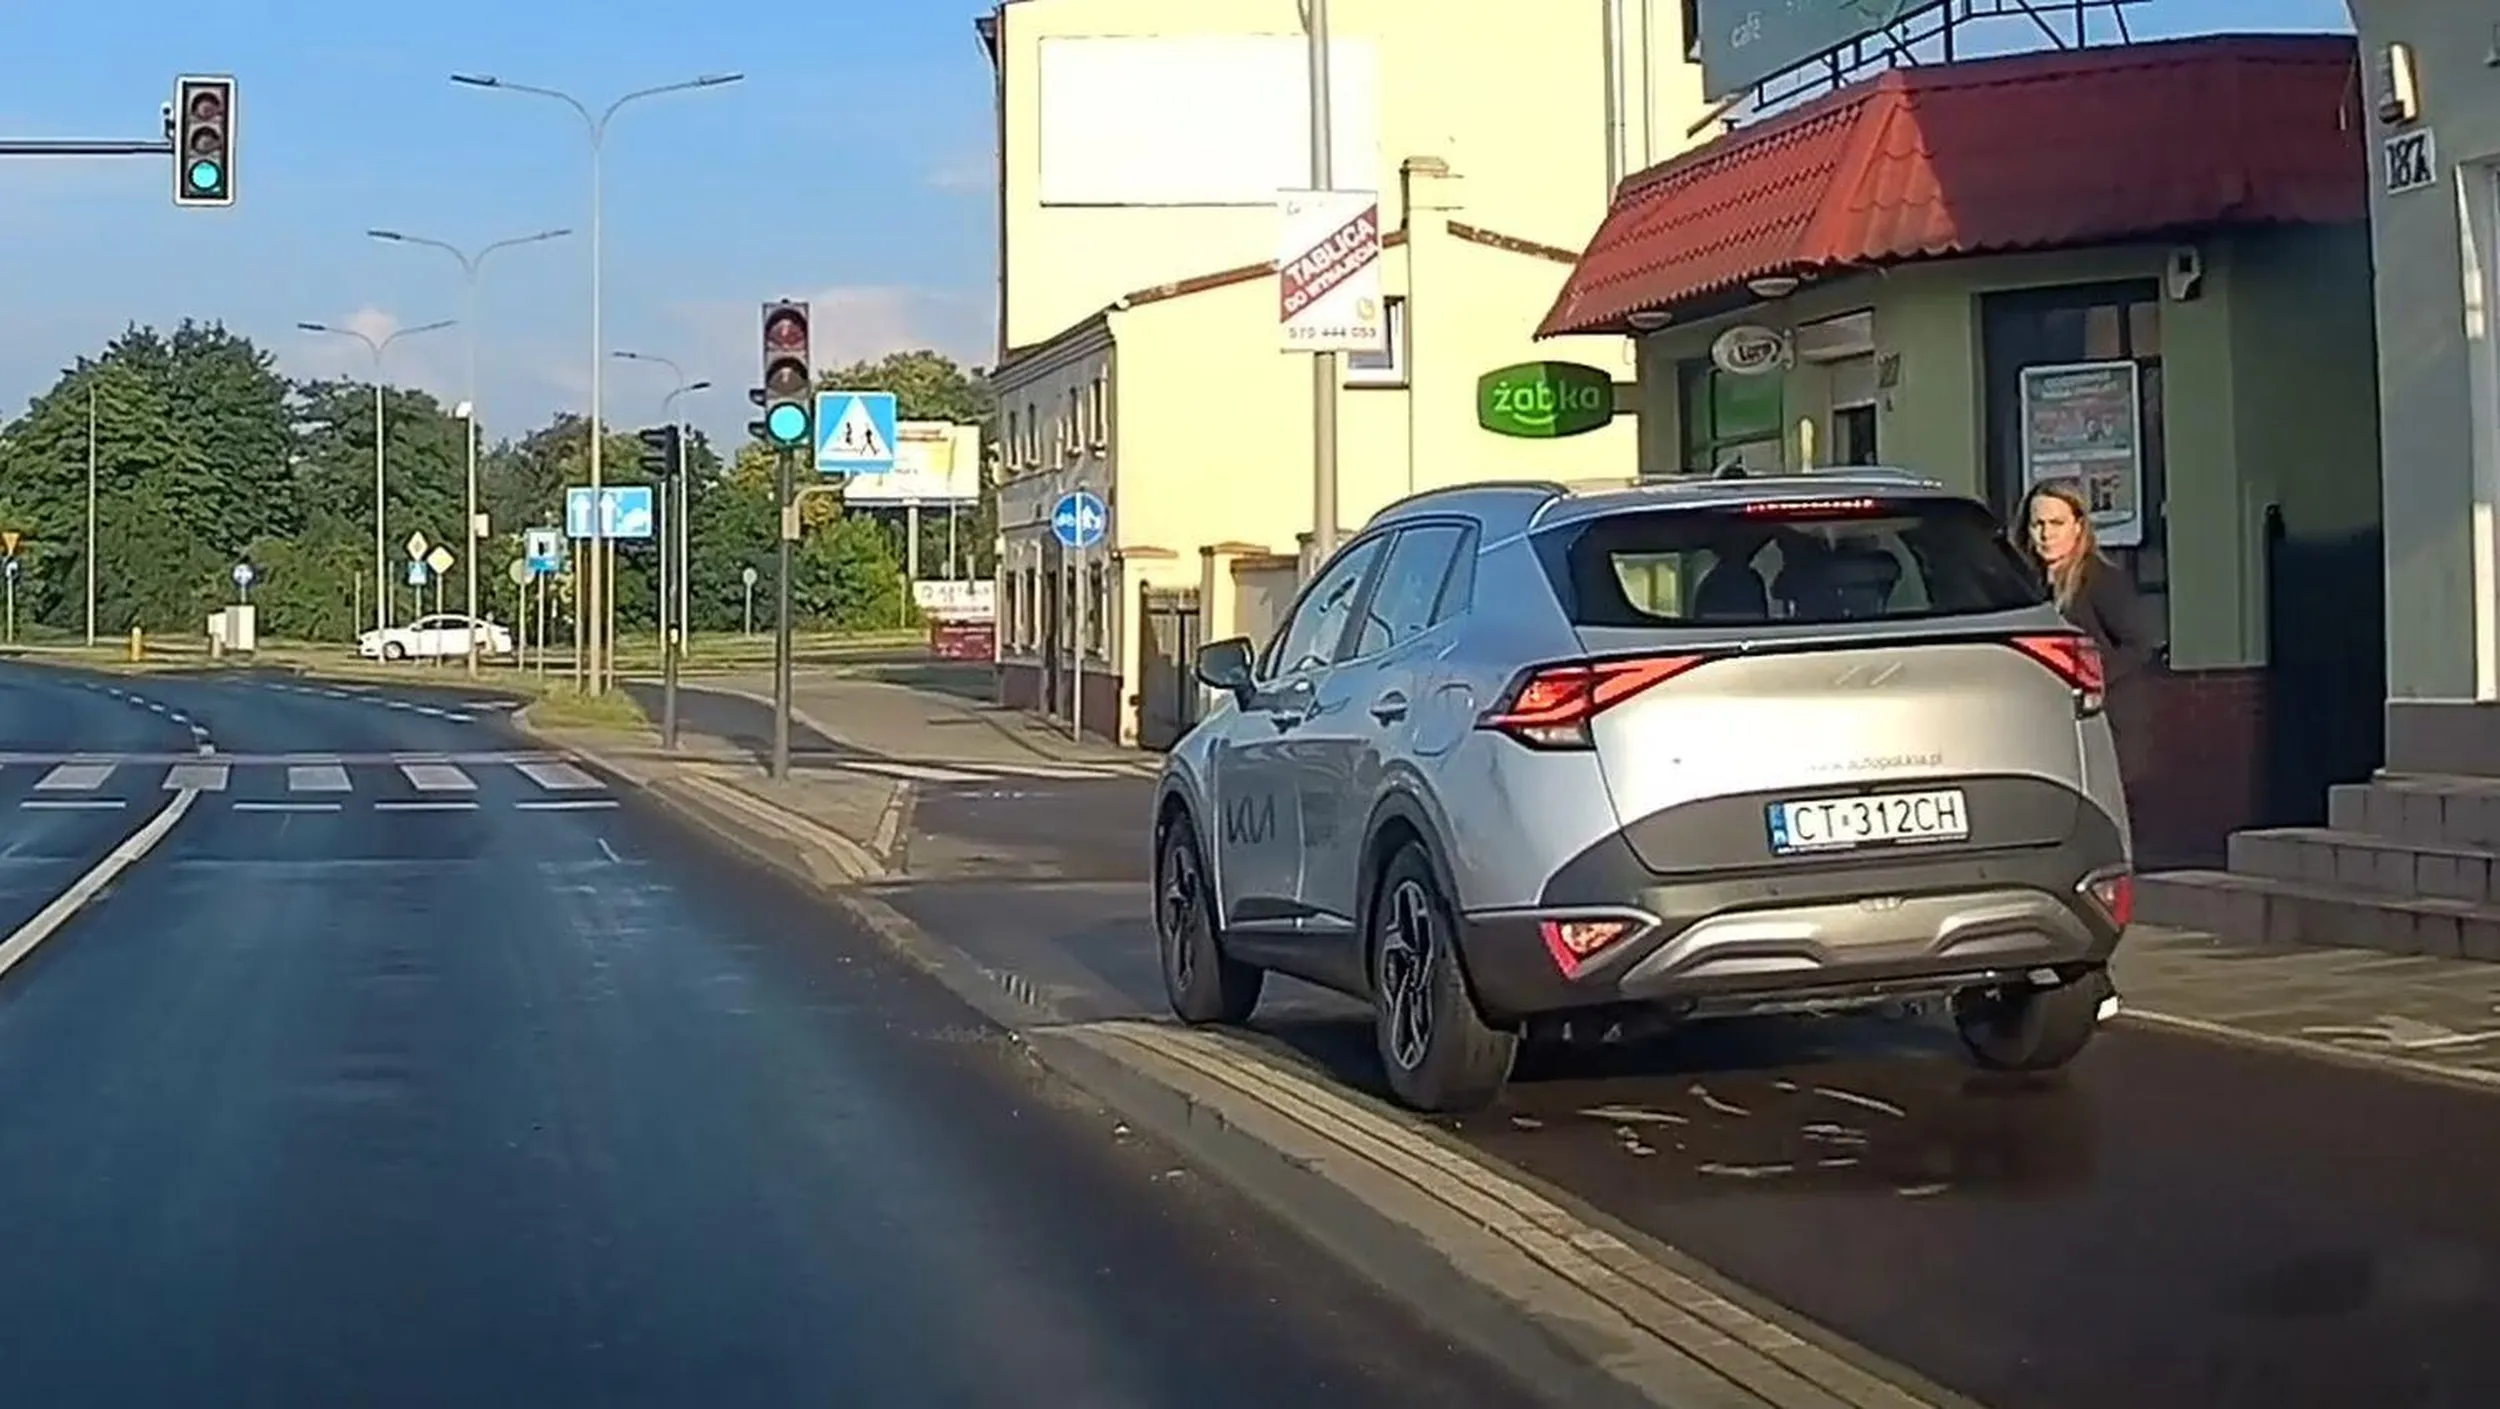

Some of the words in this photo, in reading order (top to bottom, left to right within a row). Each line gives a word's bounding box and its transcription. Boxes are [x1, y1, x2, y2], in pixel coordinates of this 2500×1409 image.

[1286, 217, 1375, 287] TABLICA
[1284, 290, 1308, 313] DO
[1493, 381, 1600, 411] żabka
[1795, 805, 1835, 840] CT
[1852, 797, 1957, 836] 312CH
